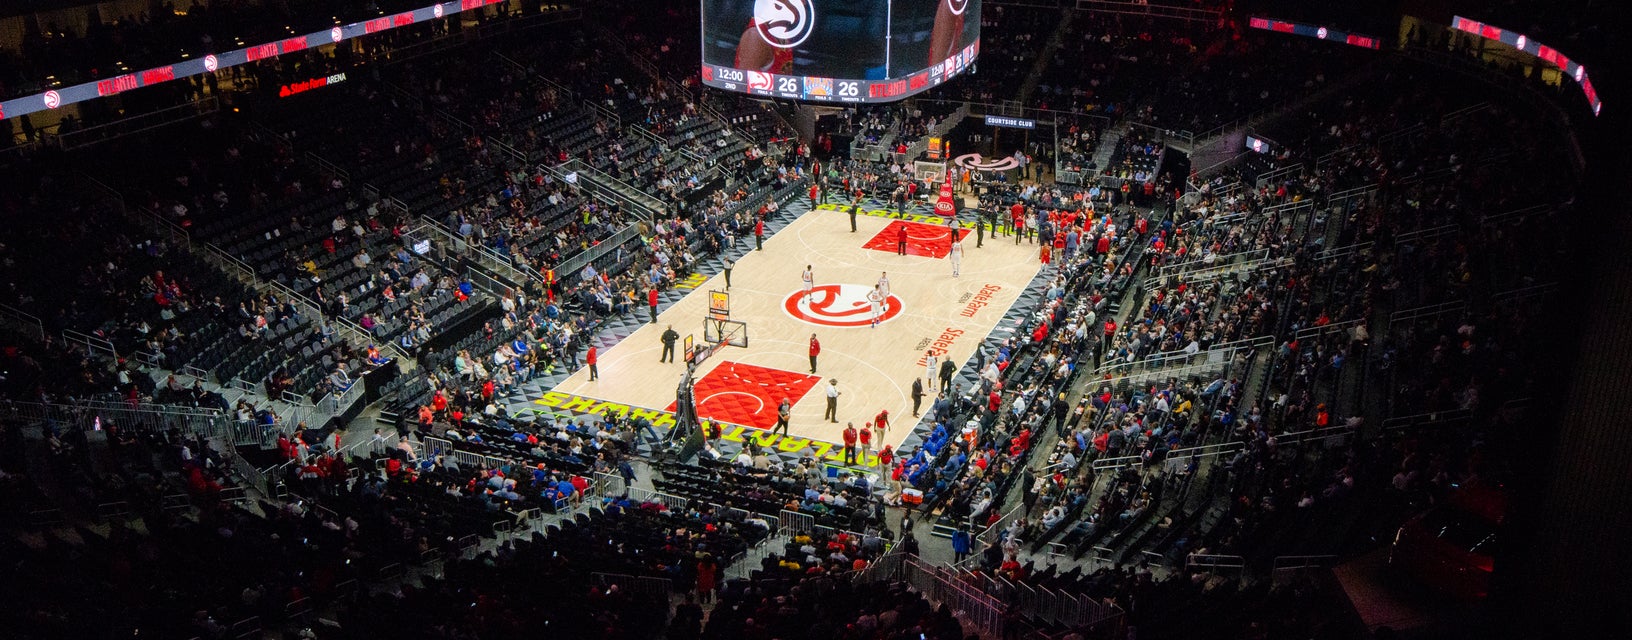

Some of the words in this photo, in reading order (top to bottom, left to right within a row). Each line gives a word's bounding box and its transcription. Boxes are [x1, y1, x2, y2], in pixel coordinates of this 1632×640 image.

[246, 43, 278, 62] ATLANTA
[98, 74, 137, 96] ATLANTA
[142, 65, 174, 86] HAWKS
[327, 72, 347, 85] ARENA
[718, 68, 744, 82] 12:00
[779, 77, 798, 93] 26
[838, 81, 859, 97] 26
[869, 79, 907, 98] ATLANTA
[987, 117, 1017, 126] COURTSIDE
